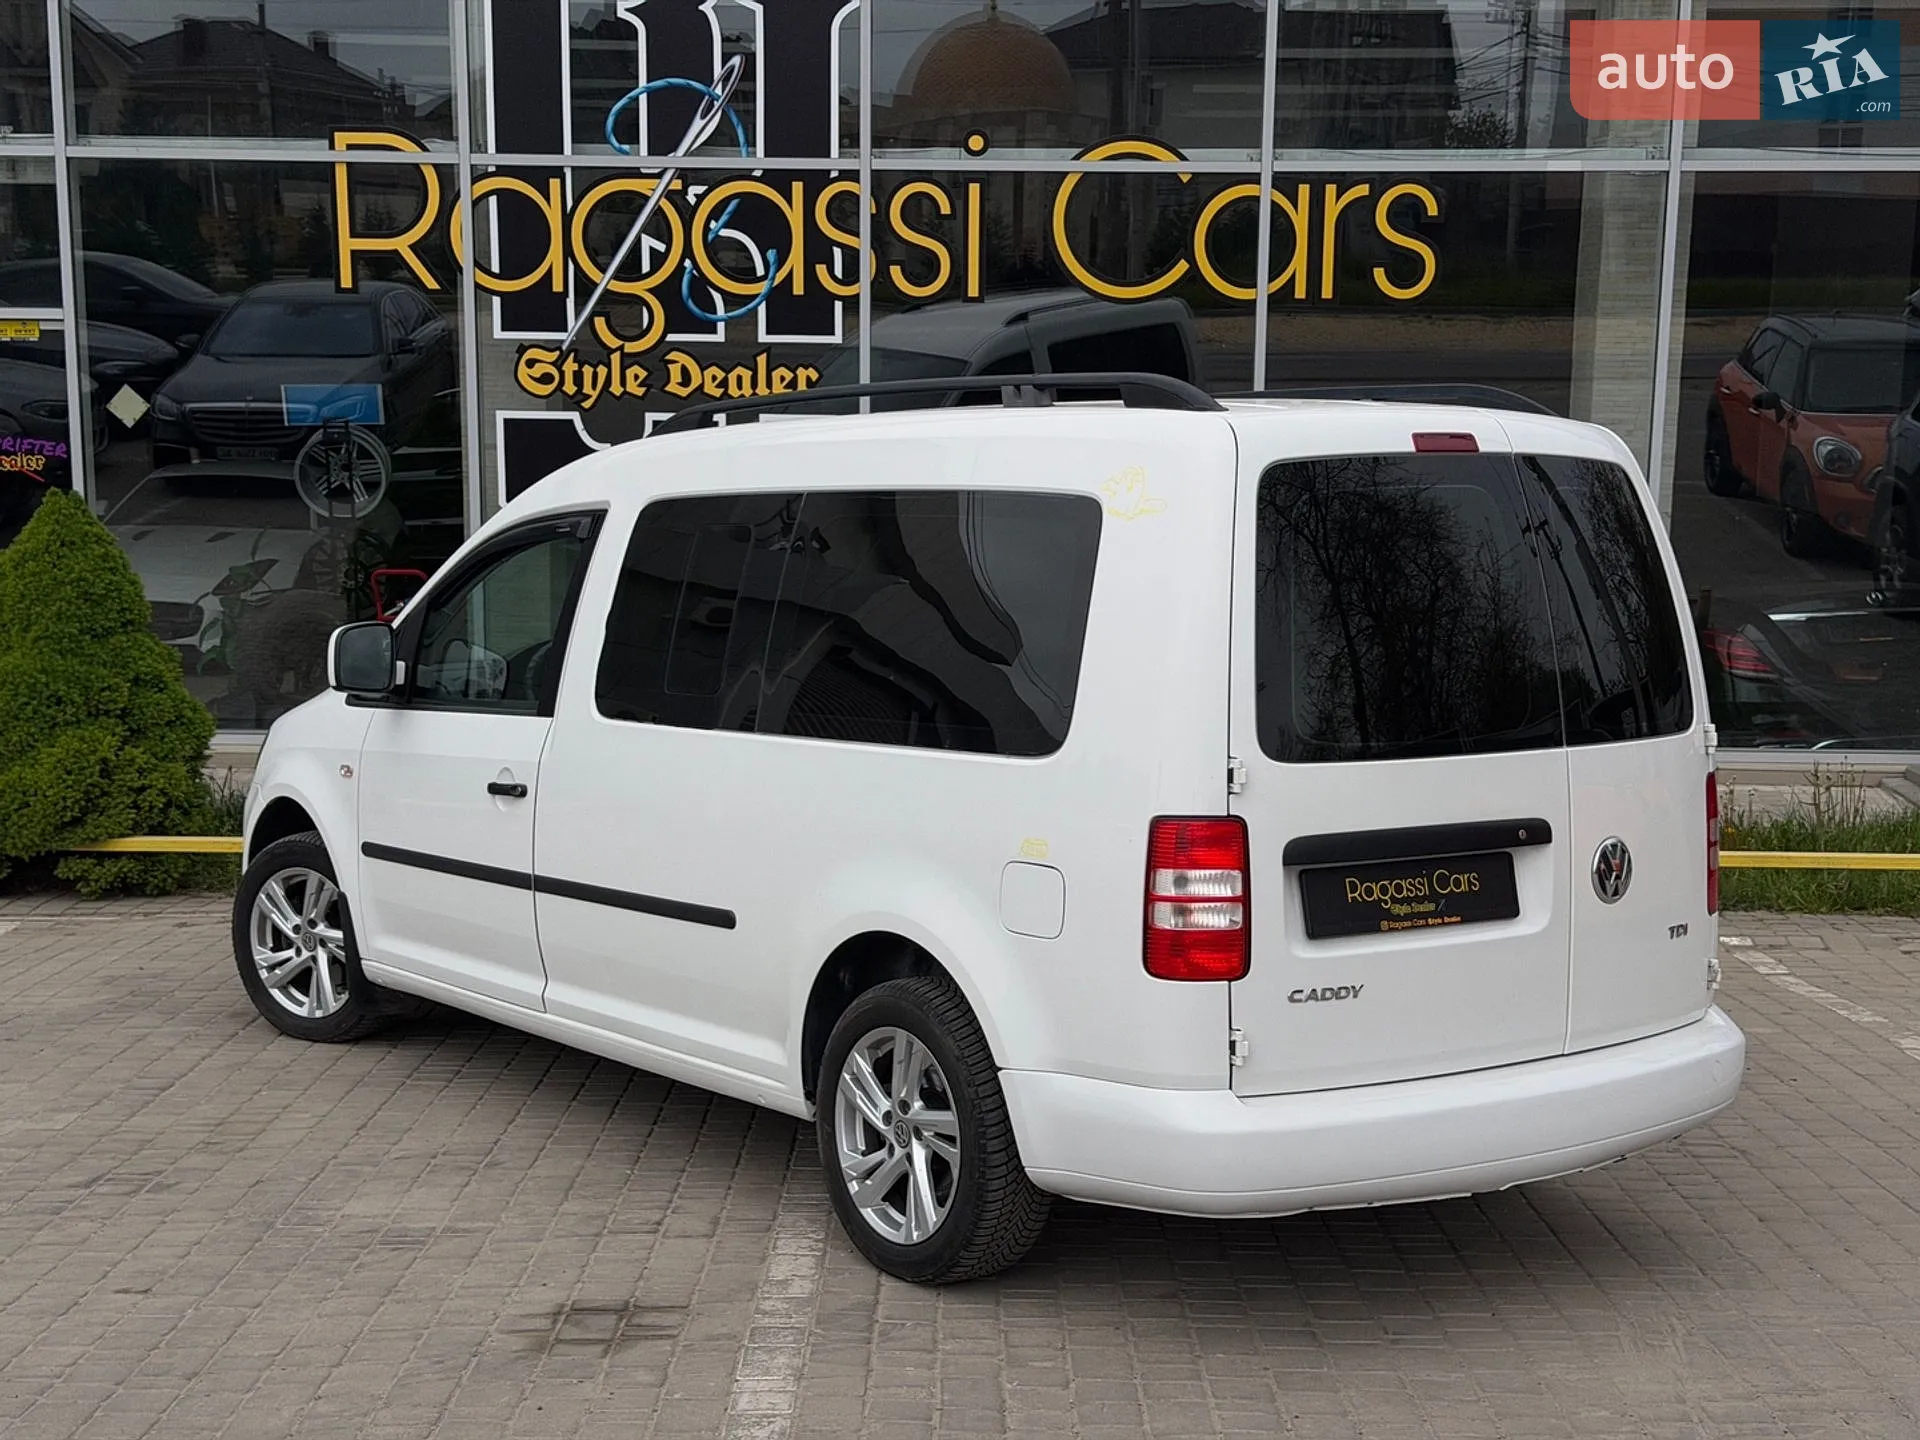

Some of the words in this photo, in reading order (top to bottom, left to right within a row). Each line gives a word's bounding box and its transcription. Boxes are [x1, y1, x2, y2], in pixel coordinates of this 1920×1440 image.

[331, 129, 986, 354] Ragassi
[1050, 138, 1440, 302] Cars
[516, 346, 649, 409] Style
[663, 350, 820, 398] Dealer
[0, 435, 68, 458] RIFTER
[1345, 869, 1430, 909] Ragassi
[1433, 869, 1481, 894] Cars
[1667, 922, 1688, 940] TDI
[1287, 984, 1364, 1004] CADDY
